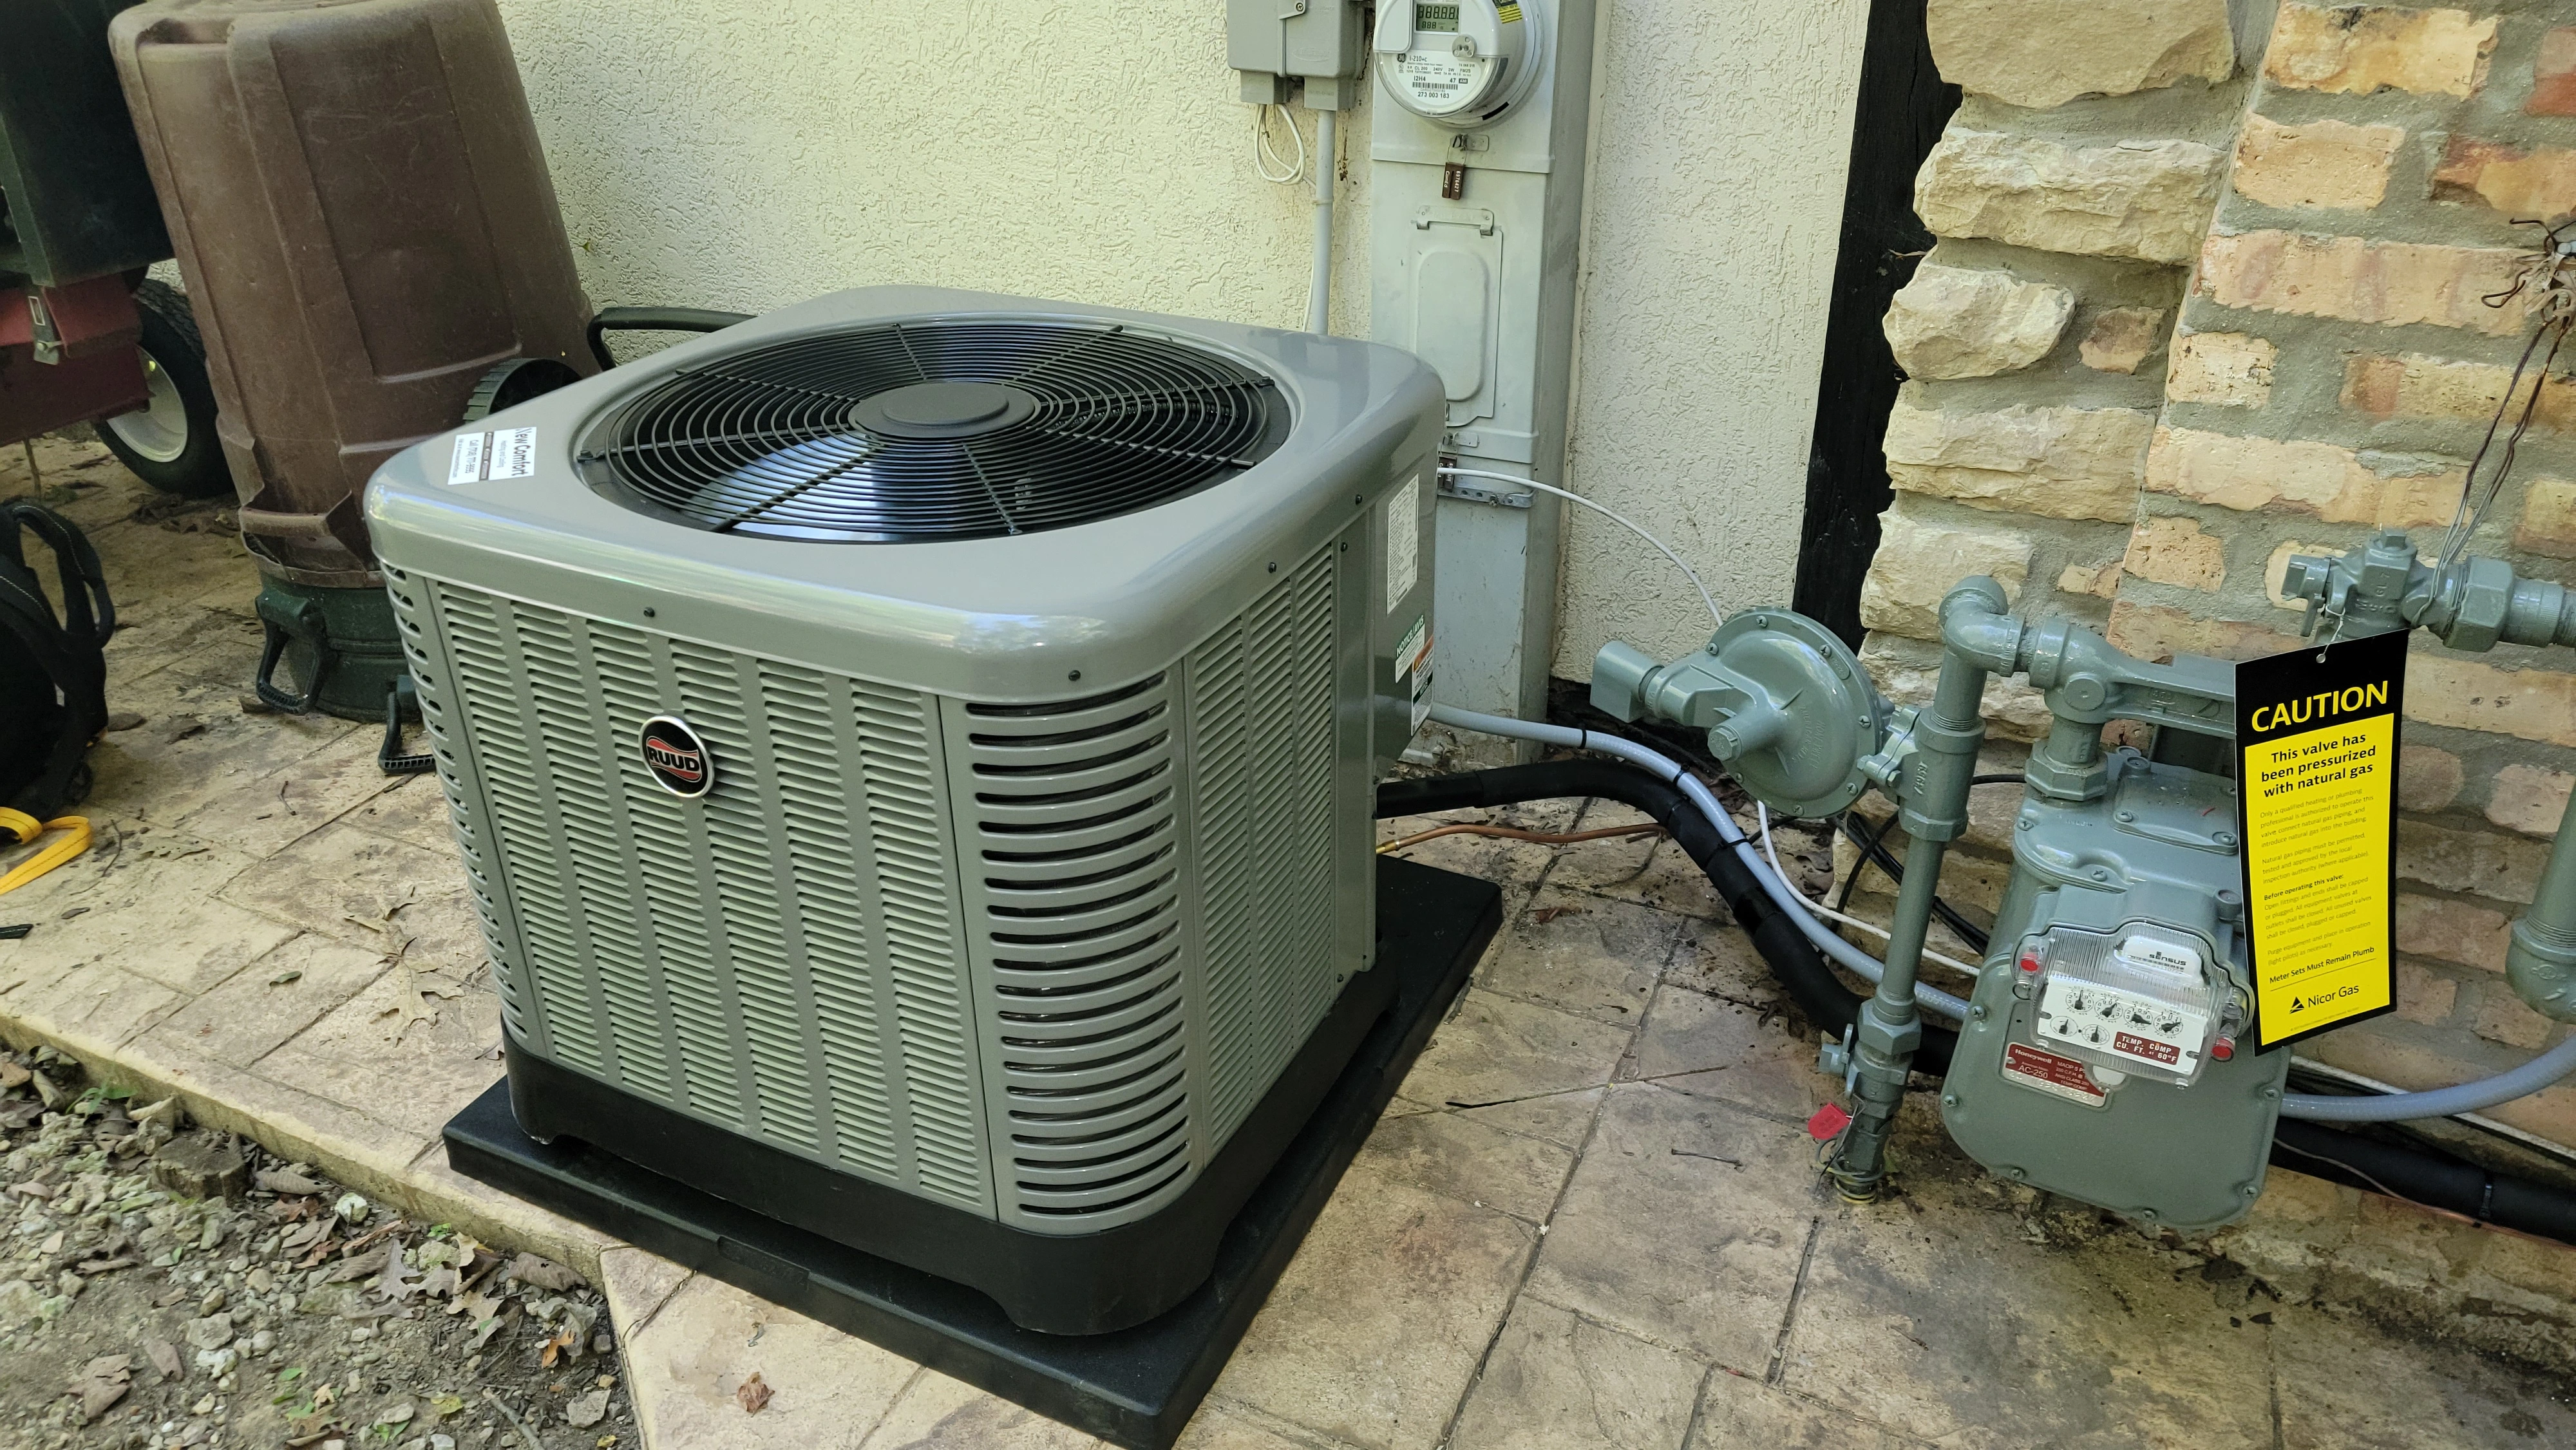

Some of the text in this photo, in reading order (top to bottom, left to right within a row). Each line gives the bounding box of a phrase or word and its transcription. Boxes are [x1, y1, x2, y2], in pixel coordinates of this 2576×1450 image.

[511, 445, 531, 476] Comfort
[1396, 614, 1425, 657] NOTICE/AVIS
[2251, 681, 2388, 732] CAUTION
[647, 747, 699, 772] RUUD
[2271, 734, 2365, 763] This valve has
[2261, 745, 2376, 782] been pressurized
[2264, 764, 2372, 797] with natural gas
[2279, 802, 2304, 813] qualified
[2305, 797, 2327, 806] heating
[2335, 788, 2362, 800] plumbing
[2260, 814, 2293, 829] professional
[2300, 804, 2331, 818] authorized
[2340, 798, 2362, 807] operate
[2278, 823, 2300, 833] connect
[2301, 817, 2321, 827] natural
[2261, 837, 2287, 847] introduce
[2288, 830, 2308, 840] natural
[2262, 854, 2282, 864] Natural
[2294, 847, 2311, 856] piping
[2262, 865, 2280, 874] tested
[2293, 854, 2318, 865] approved
[2339, 845, 2352, 853] local
[2263, 872, 2290, 884] inspection
[2291, 865, 2316, 876] authority
[2318, 860, 2337, 869] (where
[2264, 891, 2284, 901] Before
[2284, 883, 2313, 894] operating
[2280, 896, 2299, 905] fittings
[2348, 876, 2369, 887] capped
[2304, 896, 2333, 909] equipment
[2266, 921, 2284, 930] outlets
[2334, 899, 2353, 909] unused
[2266, 931, 2278, 939] shall
[2306, 916, 2327, 928] plugged
[2283, 938, 2311, 951] equipment
[2324, 930, 2338, 939] place
[2345, 921, 2371, 932] operation
[2149, 951, 2186, 966] sensus
[2268, 957, 2282, 966] (light
[2282, 951, 2298, 962] pilots)
[2269, 946, 2374, 984] Meter Sets Must Remain Plumb
[2307, 985, 2359, 1008] Nicor Gas
[2116, 1042, 2129, 1051] CU.
[2134, 1046, 2145, 1055] FT.
[2157, 1053, 2177, 1062] 60°F
[2121, 1035, 2144, 1048] TEMP.
[2014, 1048, 2052, 1064] Honeywell
[2057, 1061, 2074, 1070] MAOP
[2018, 1064, 2049, 1079] AC-250
